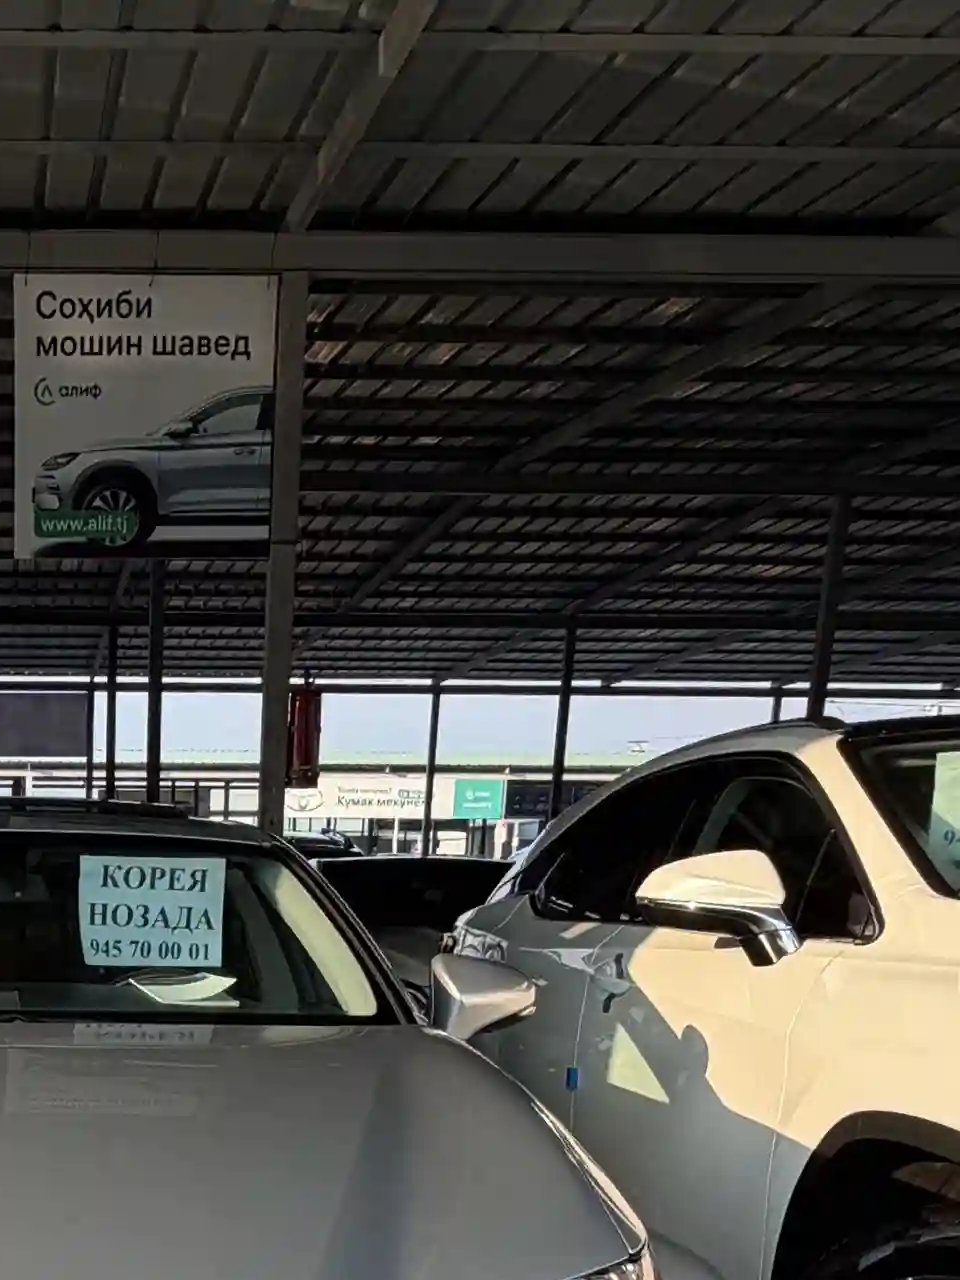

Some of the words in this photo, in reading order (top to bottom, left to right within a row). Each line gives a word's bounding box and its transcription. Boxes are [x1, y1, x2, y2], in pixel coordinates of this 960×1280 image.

[36, 289, 153, 323] Соҳиби
[35, 335, 143, 357] мошин
[152, 335, 251, 361] шавед
[58, 382, 102, 400] алиф
[40, 515, 128, 535] www.alif.tj
[100, 864, 209, 892] КОРЕЯ
[88, 902, 216, 935] НОЗАДА
[90, 939, 122, 958] 945
[129, 940, 152, 959] 70
[158, 941, 182, 960] 00
[188, 943, 210, 961] 01
